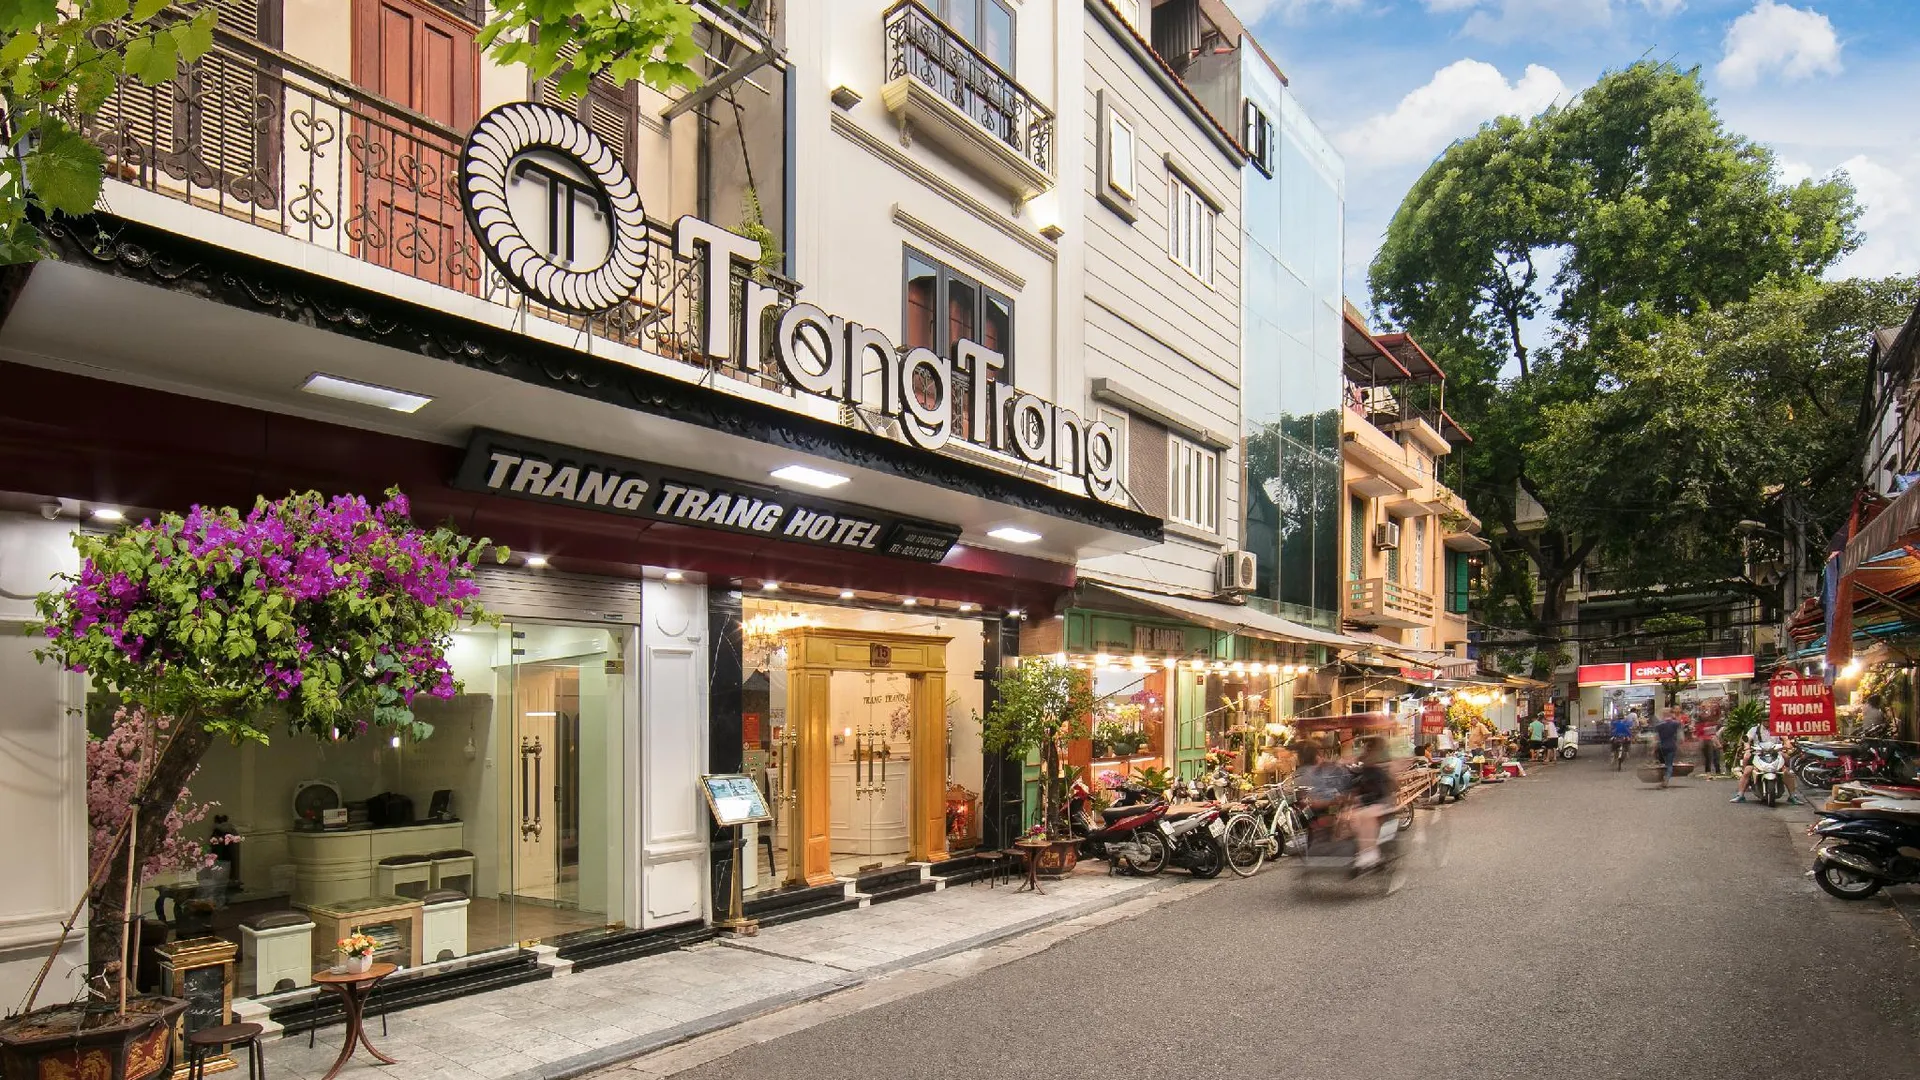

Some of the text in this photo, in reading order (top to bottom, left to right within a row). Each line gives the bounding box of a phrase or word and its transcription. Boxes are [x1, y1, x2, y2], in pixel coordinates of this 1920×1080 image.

[673, 215, 1118, 501] Trang Trang
[487, 452, 881, 550] TRANG TRANG HOTEL
[1136, 626, 1186, 651] THE GARDEN
[1773, 681, 1798, 697] CHẢ
[1782, 703, 1823, 715] THOAN
[1775, 720, 1831, 735] HẠ LONG
